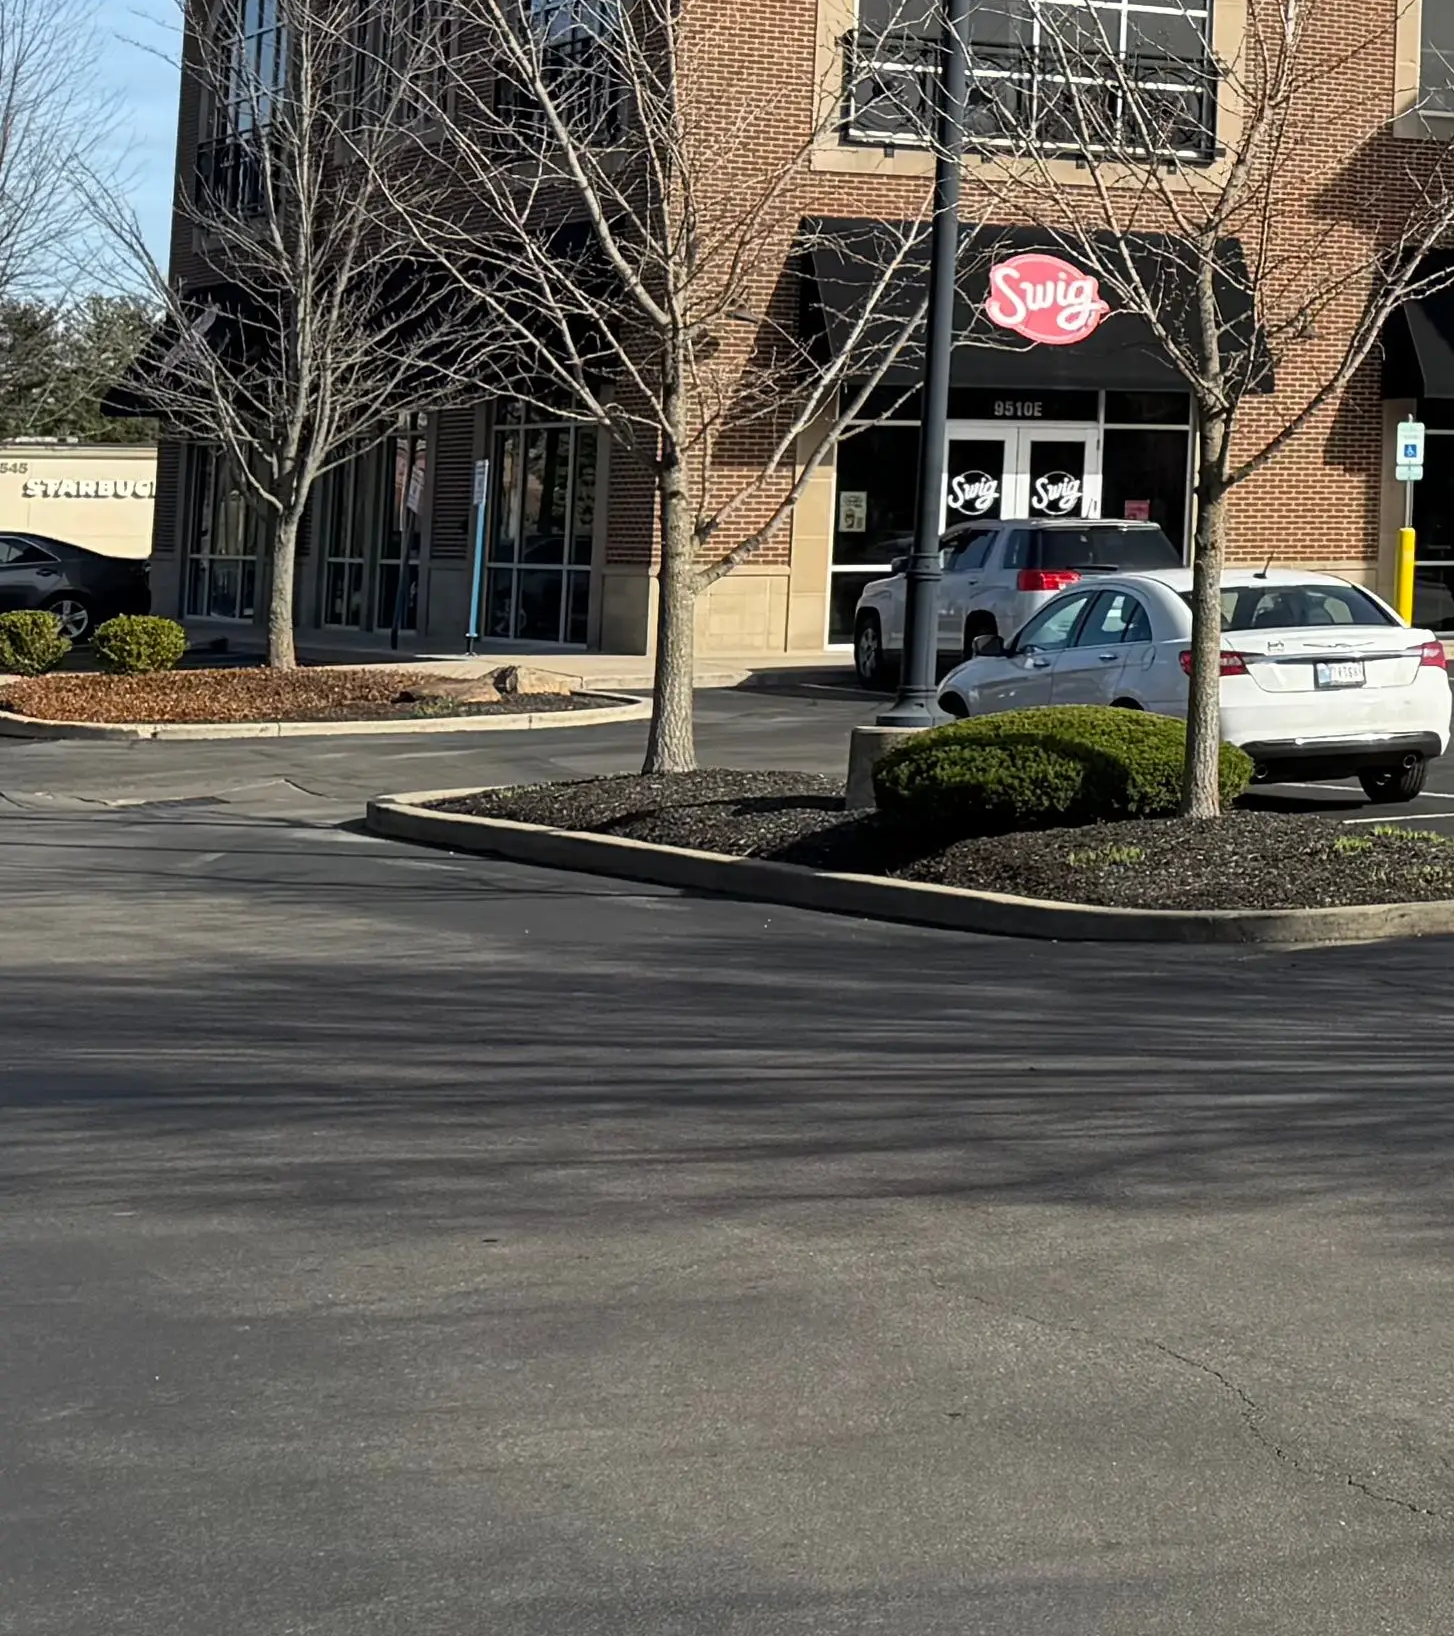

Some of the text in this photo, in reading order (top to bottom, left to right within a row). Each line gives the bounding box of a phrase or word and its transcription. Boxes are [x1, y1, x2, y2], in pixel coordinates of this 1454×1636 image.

[990, 266, 1103, 331] Swig
[993, 400, 1043, 417] 9510E
[948, 476, 1000, 509] Swig
[1032, 477, 1083, 510] Swig
